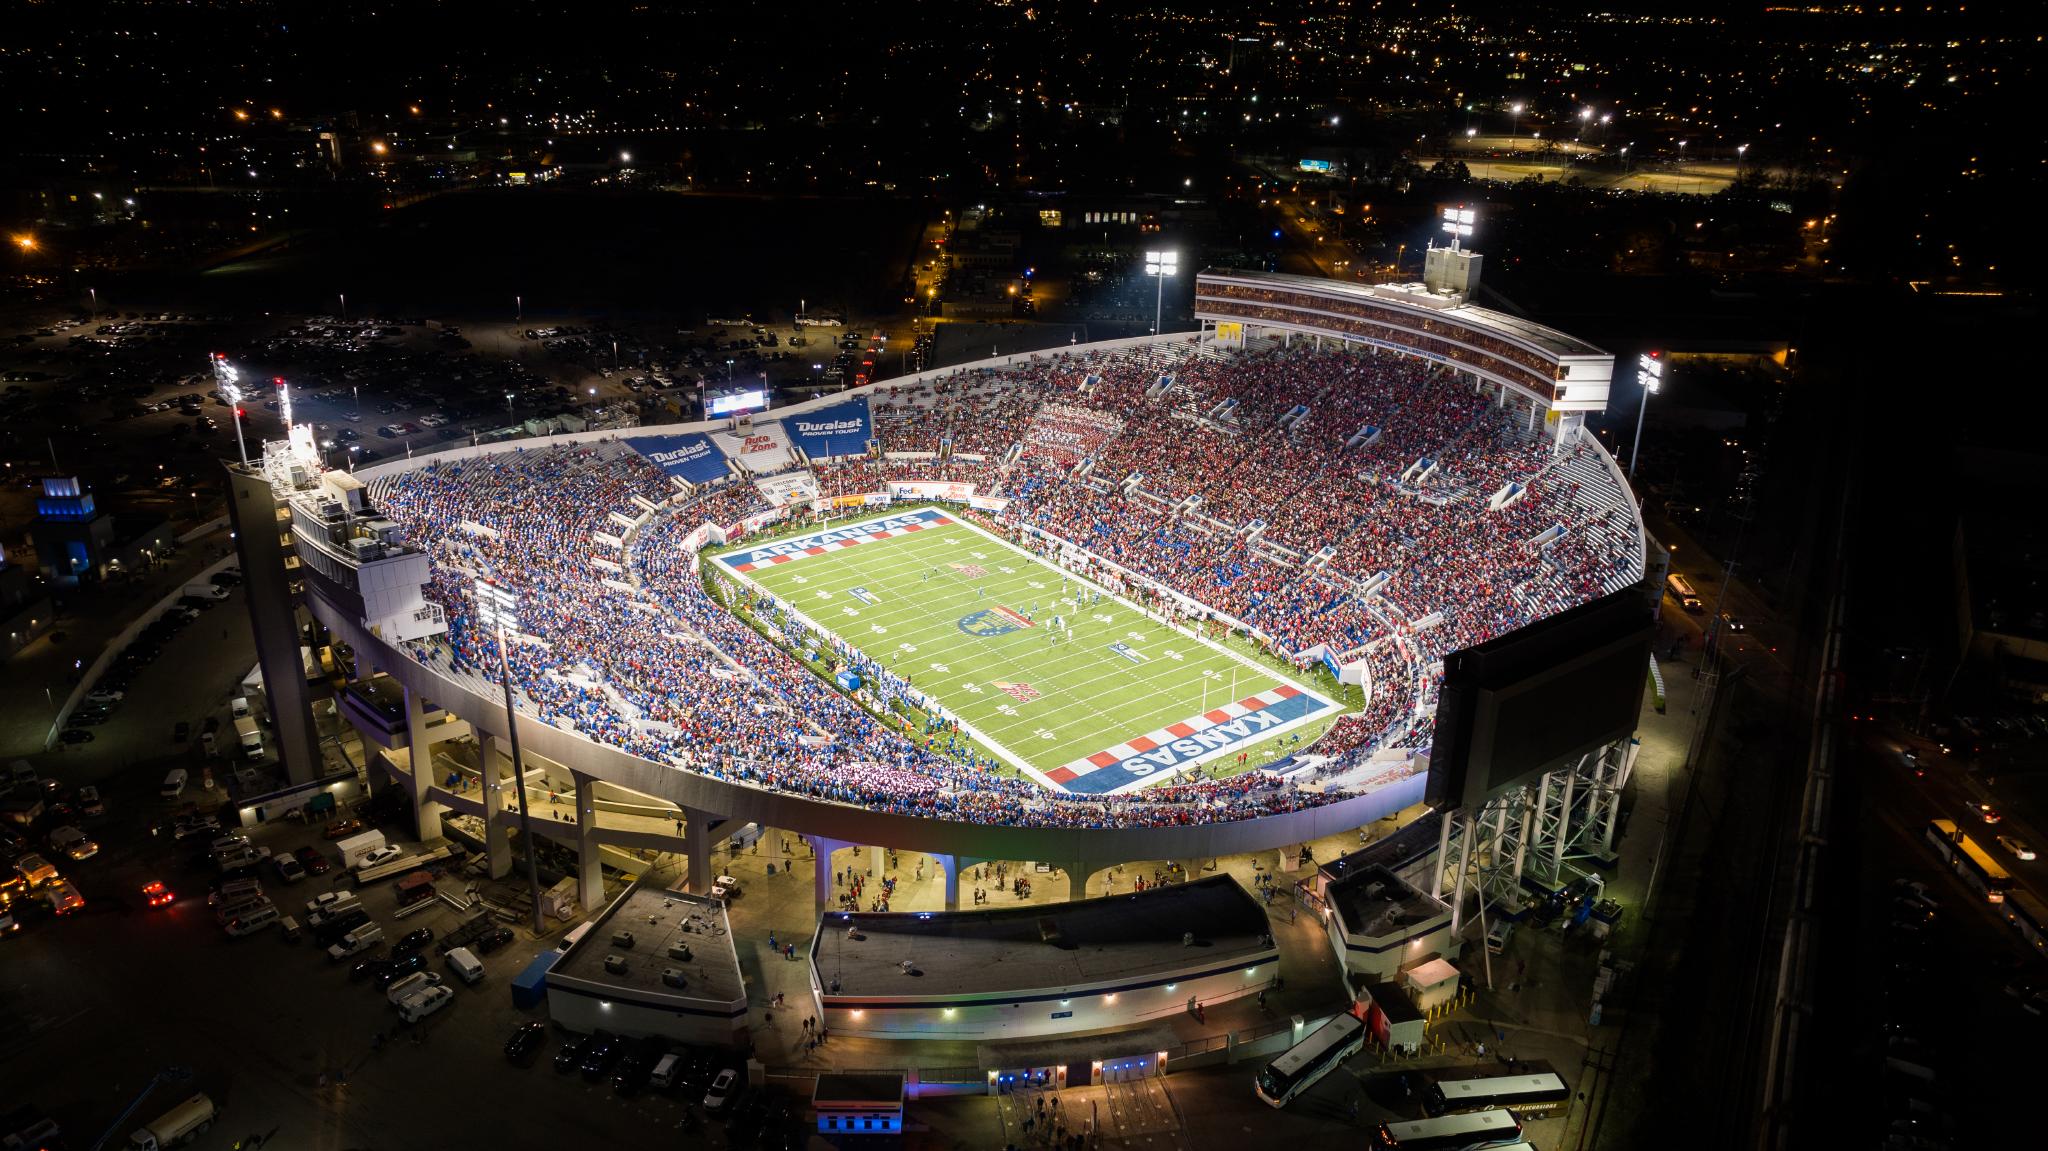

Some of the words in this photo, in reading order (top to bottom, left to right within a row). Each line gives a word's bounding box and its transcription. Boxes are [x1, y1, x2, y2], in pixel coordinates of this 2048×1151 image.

[795, 418, 863, 432] Duralast
[744, 435, 770, 445] Auto
[802, 429, 833, 437] PROVEN
[649, 440, 710, 463] Duralast
[750, 442, 778, 453] Zone
[663, 456, 689, 467] PROVEN
[690, 450, 711, 461] TOUGH
[750, 514, 922, 562] ARKANSAS
[1033, 729, 1053, 739] 10
[1121, 711, 1284, 776] KANSAS
